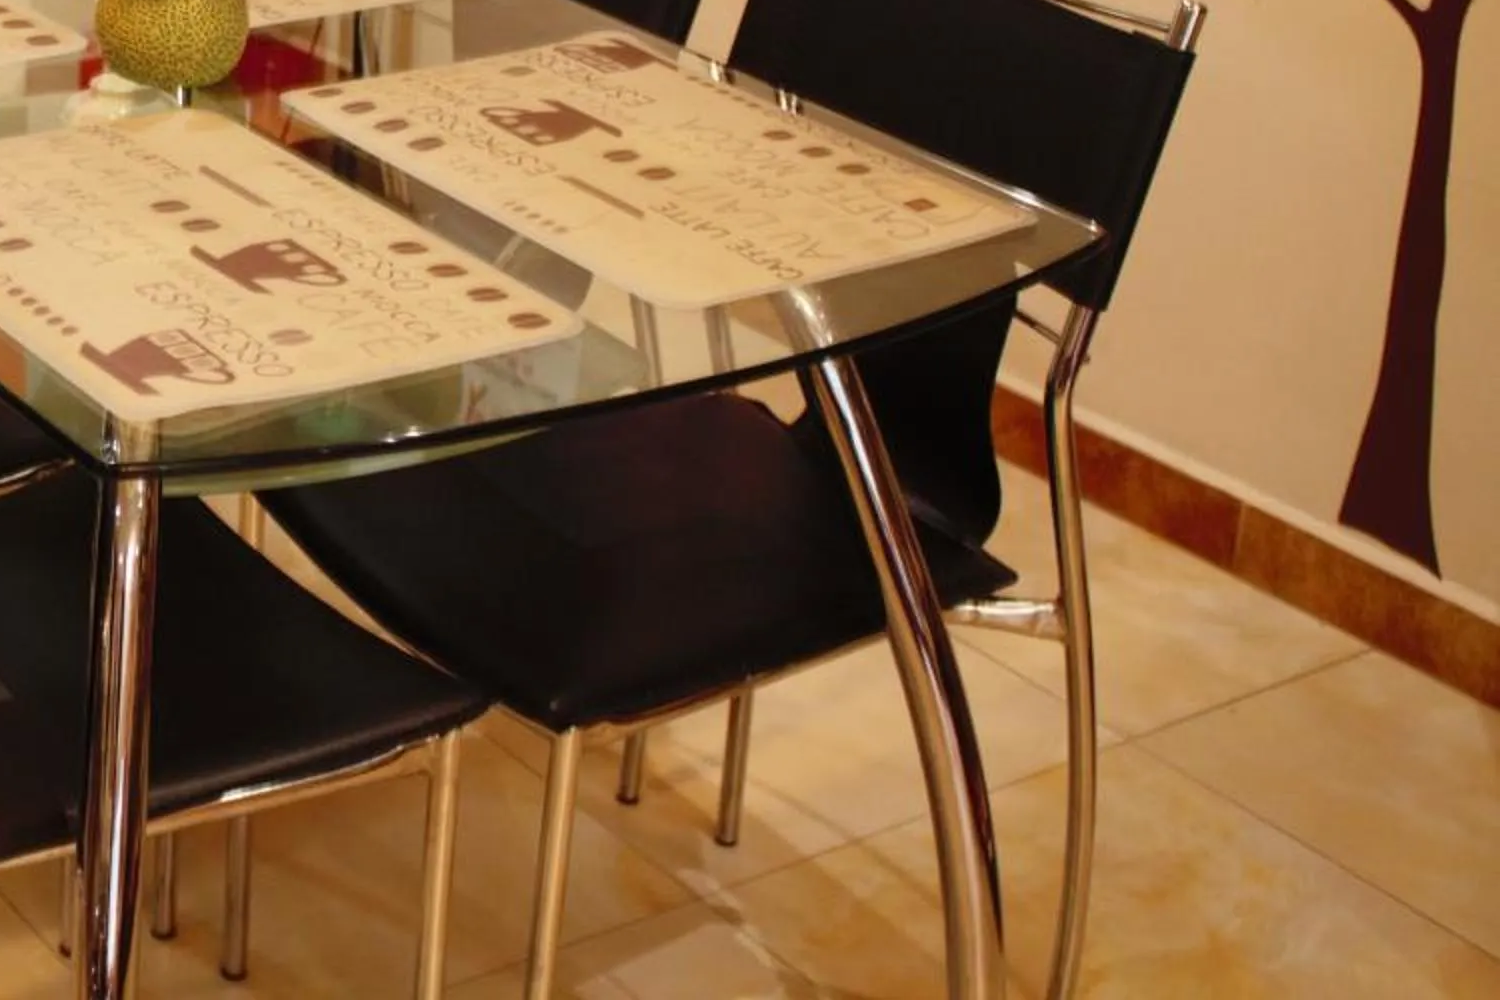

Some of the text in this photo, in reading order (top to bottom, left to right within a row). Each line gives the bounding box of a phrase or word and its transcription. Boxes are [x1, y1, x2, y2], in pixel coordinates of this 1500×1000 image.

[270, 208, 433, 292] ESPRESSO
[645, 201, 734, 239] LATTE
[133, 280, 300, 381] ESPRESSO
[346, 287, 452, 343] MOCCA
